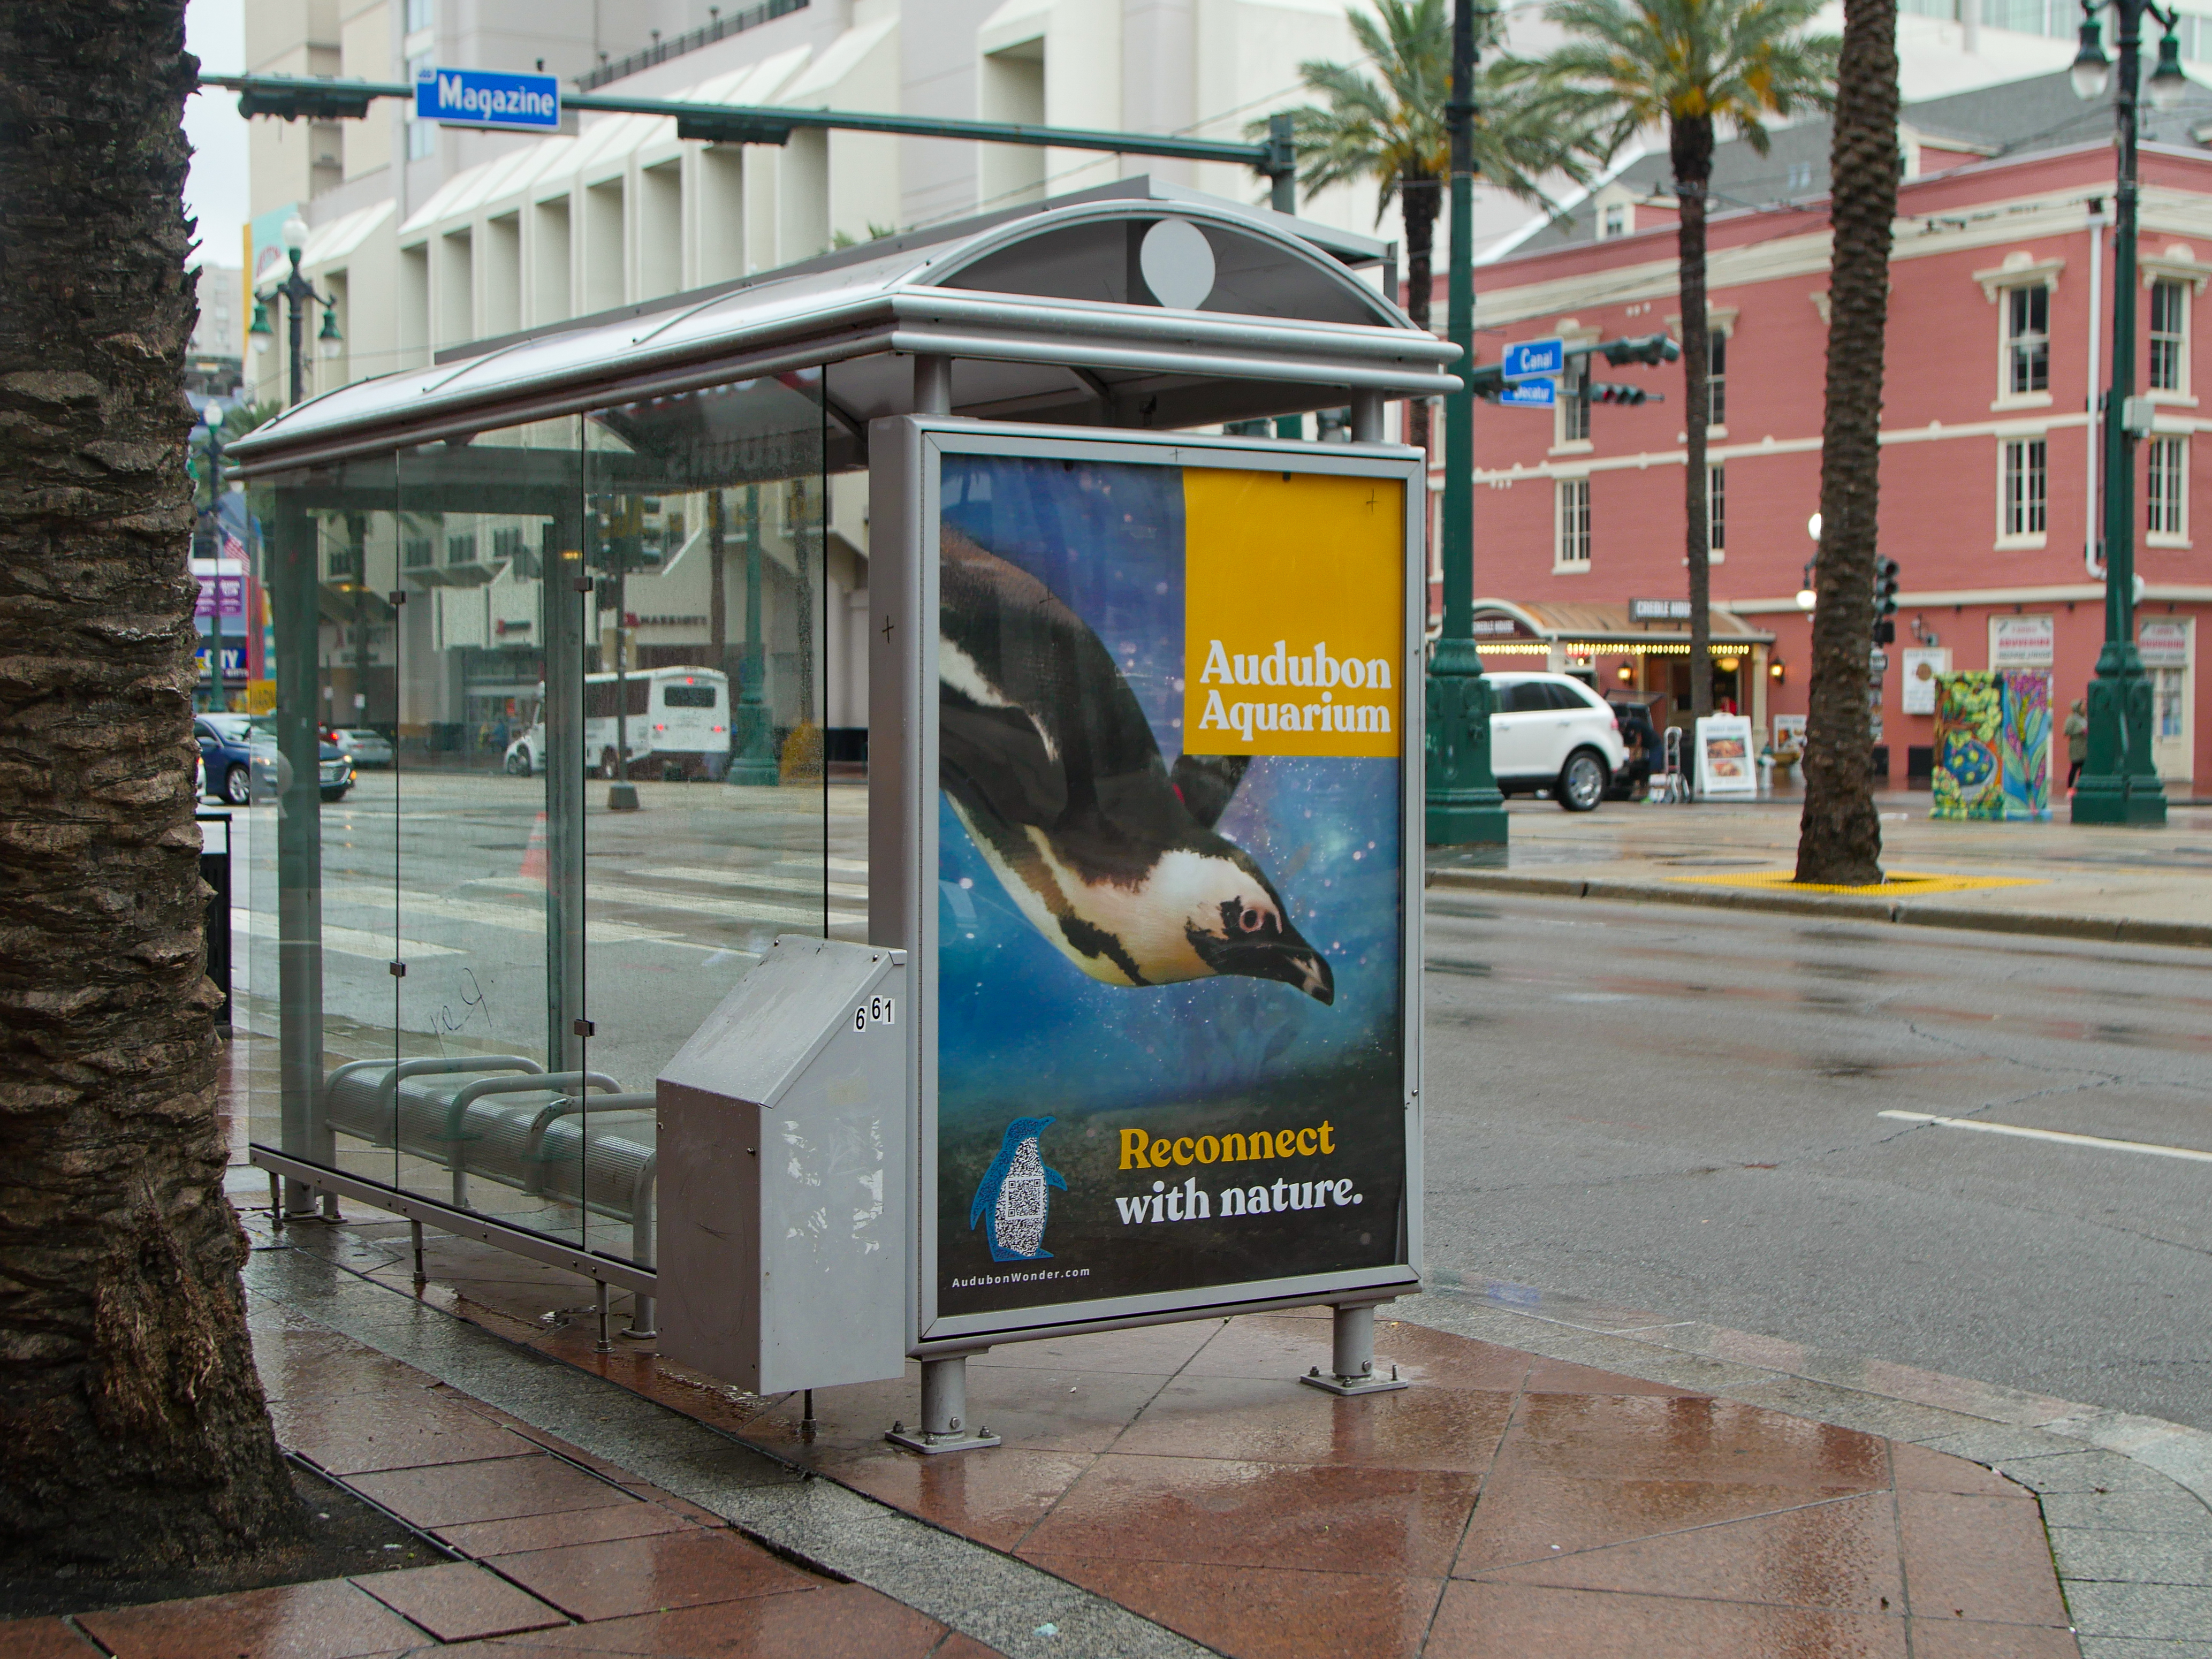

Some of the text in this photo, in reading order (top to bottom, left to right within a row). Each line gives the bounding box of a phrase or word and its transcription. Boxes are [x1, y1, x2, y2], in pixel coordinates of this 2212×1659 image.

[438, 73, 555, 120] Magazine
[1521, 348, 1553, 372] Canal
[1636, 600, 1692, 617] CREOLE HOU
[1199, 640, 1392, 688] Audubon
[1198, 689, 1391, 741] Aquarium
[1119, 1120, 1335, 1170] Reconnect
[1115, 1177, 1363, 1224] with nature.
[952, 1268, 1090, 1288] AudubonWonder.com
